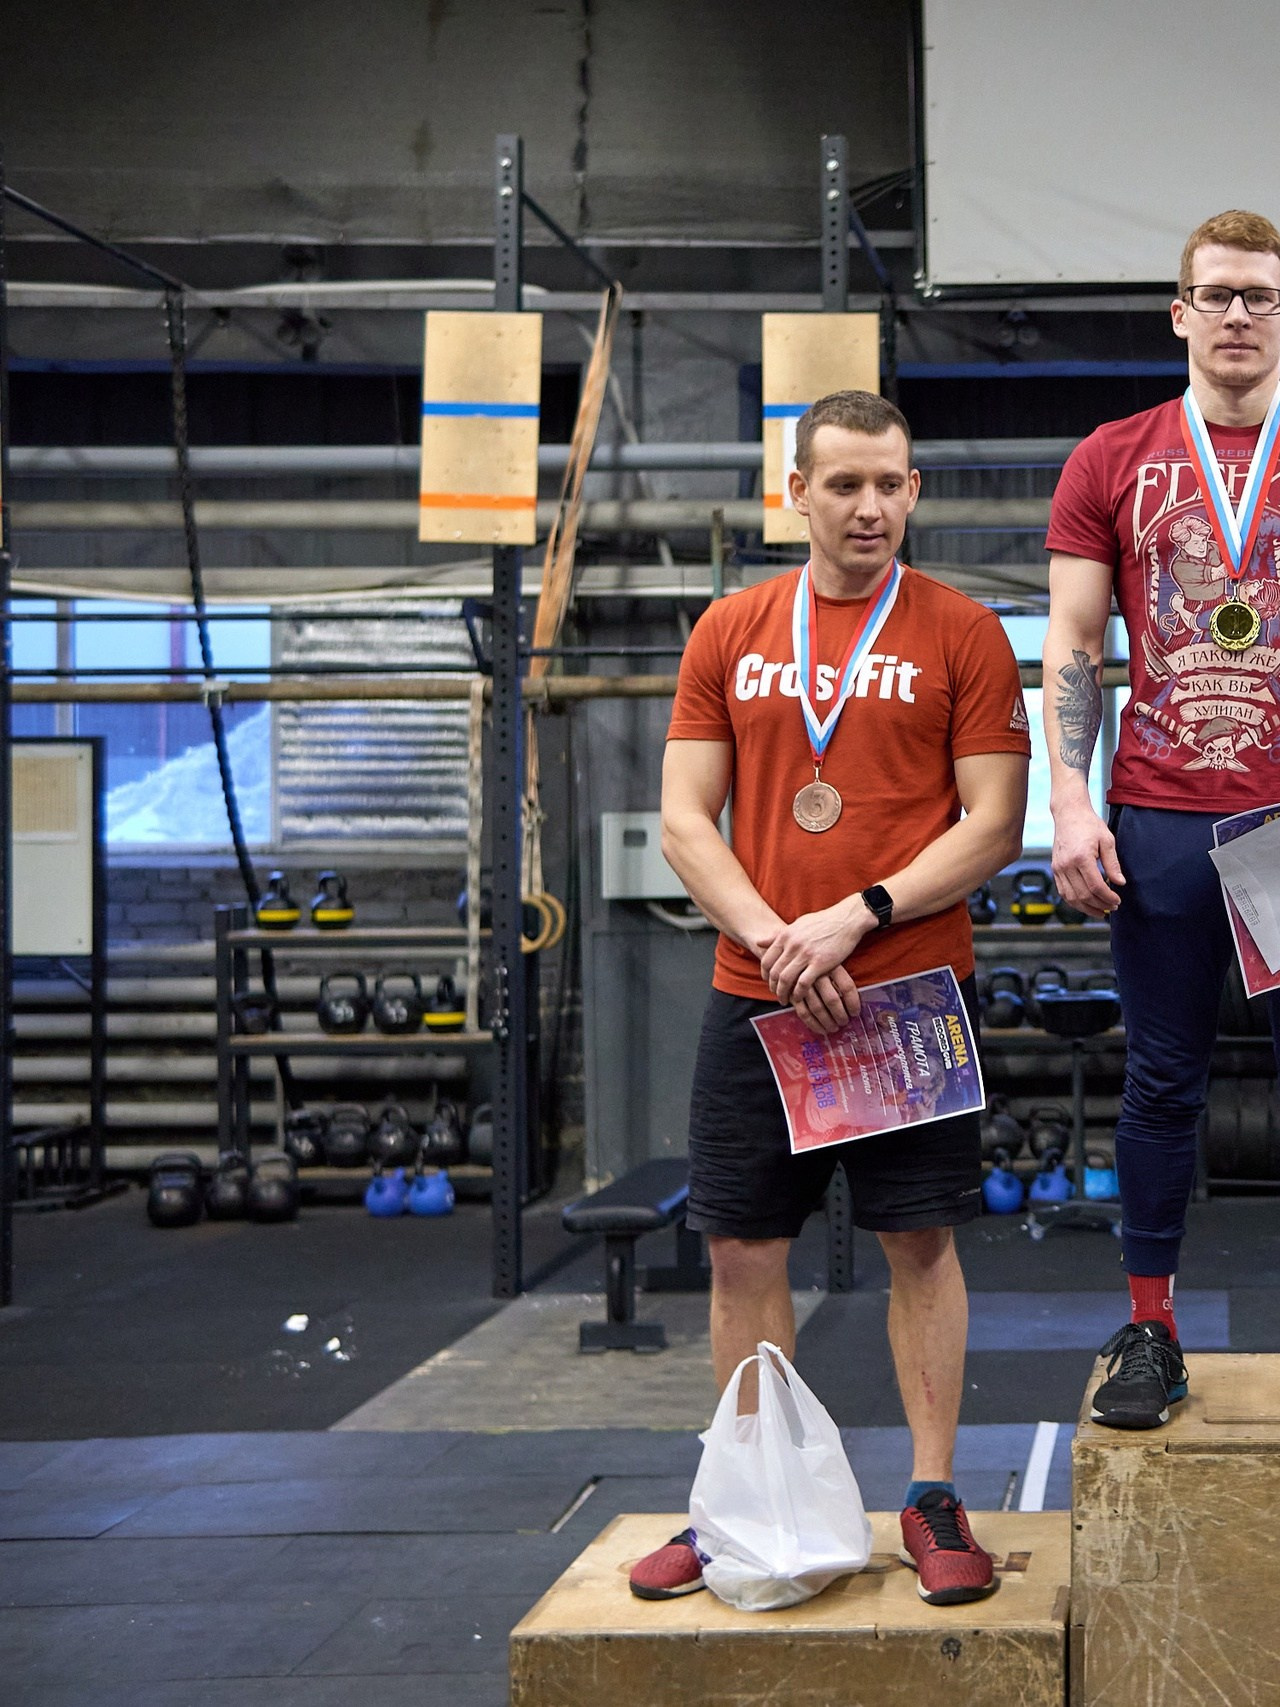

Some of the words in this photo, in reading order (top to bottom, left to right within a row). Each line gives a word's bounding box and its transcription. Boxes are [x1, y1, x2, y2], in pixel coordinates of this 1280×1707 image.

[1216, 449, 1254, 458] REBE
[1177, 655, 1186, 668] Я
[1249, 653, 1277, 668] ЖЕ
[735, 653, 920, 704] CrosFit
[1192, 680, 1223, 692] КАК
[1229, 680, 1253, 693] ВЫ
[1194, 705, 1254, 719] ХУЛИГАН
[808, 789, 825, 818] 3
[887, 1016, 913, 1089] награждается
[905, 1021, 930, 1077] ГРАМОТА
[945, 1014, 969, 1068] ARENA
[801, 1041, 829, 1109] РЕКОРДОВ
[860, 1065, 872, 1095] место
